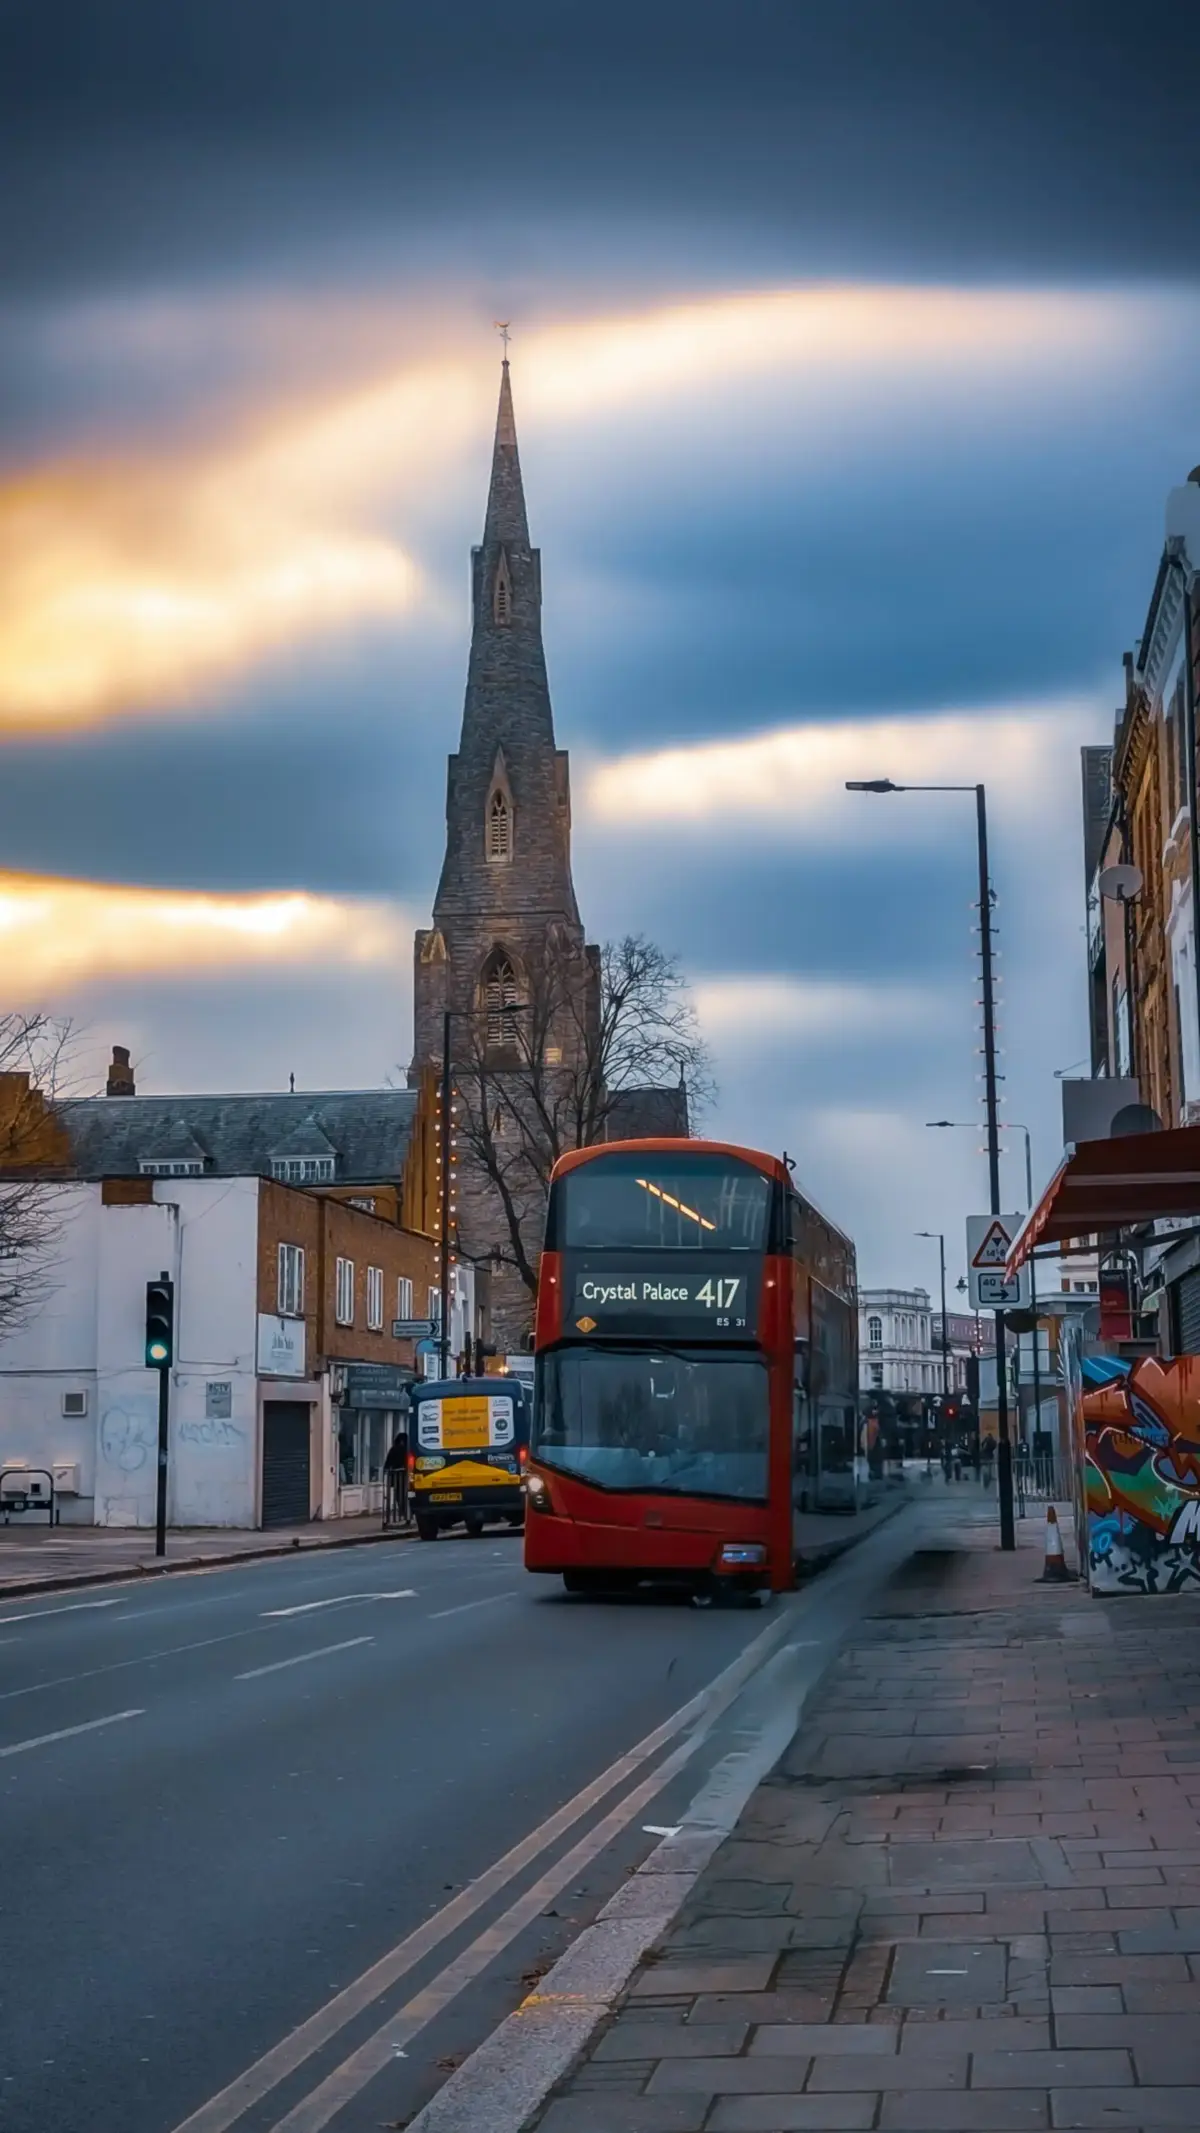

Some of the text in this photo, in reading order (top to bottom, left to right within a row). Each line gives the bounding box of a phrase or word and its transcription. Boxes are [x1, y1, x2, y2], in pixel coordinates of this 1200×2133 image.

[982, 1278, 996, 1286] 40
[582, 1278, 741, 1309] Crystal Palace 417
[716, 1317, 746, 1327] ES 31
